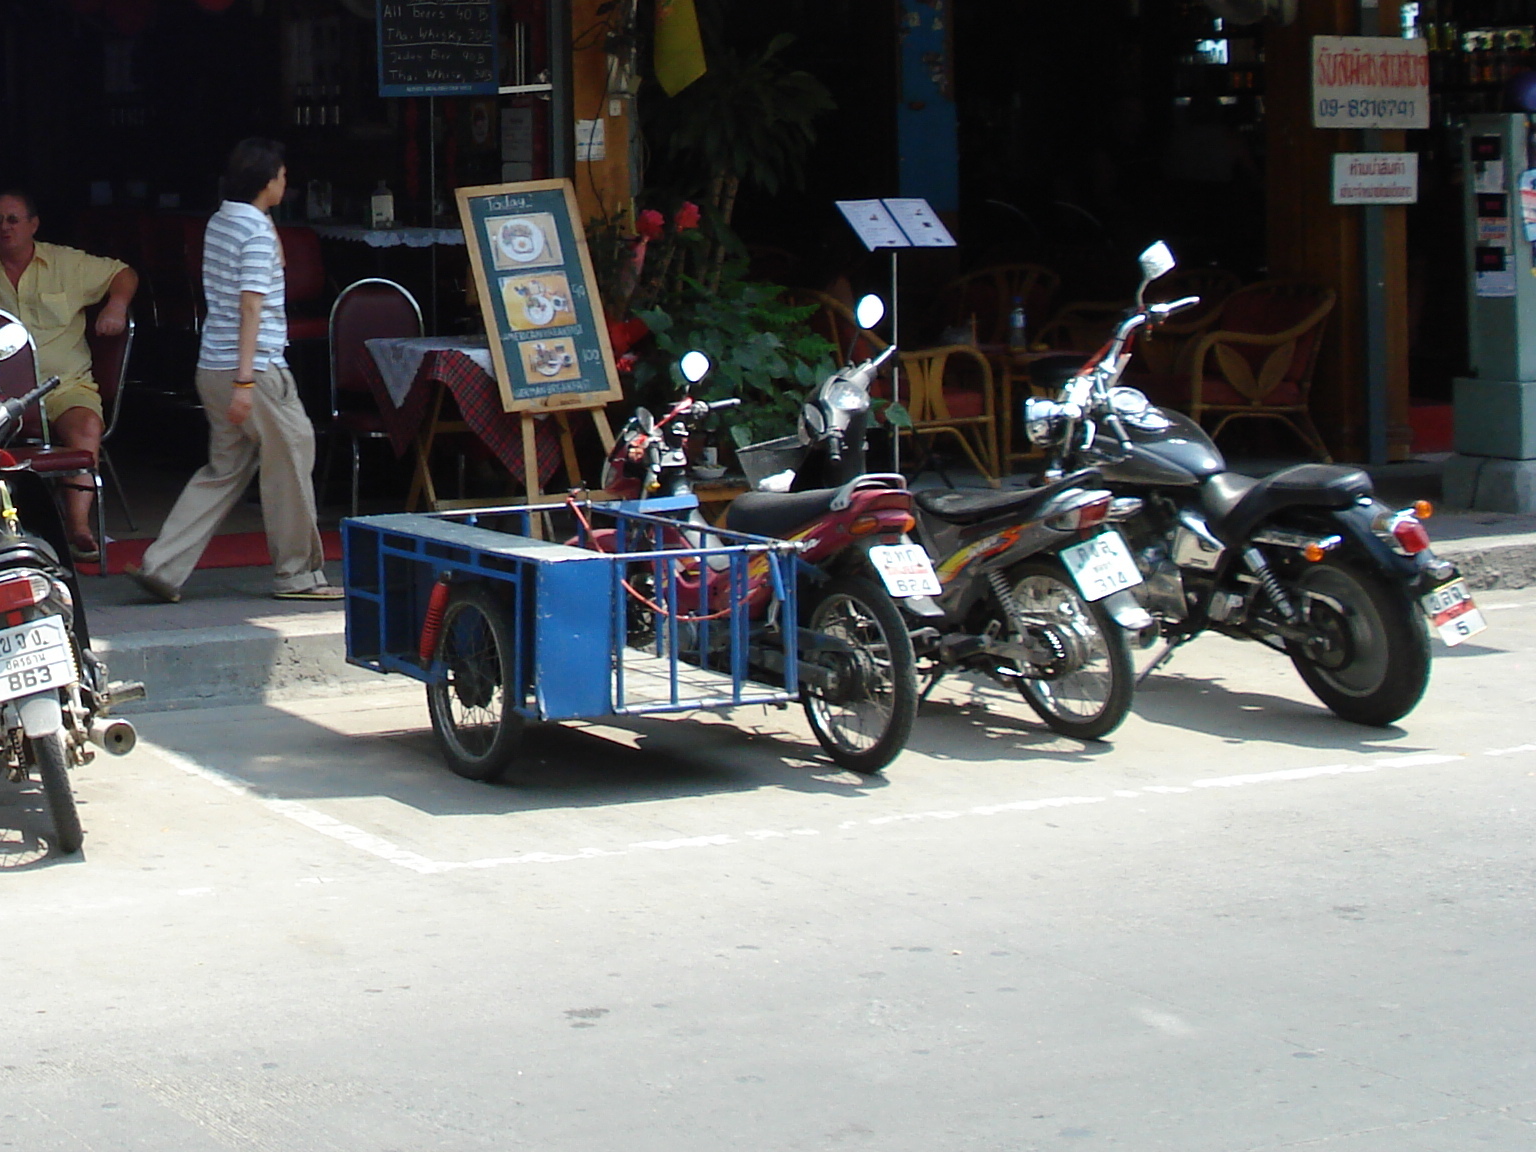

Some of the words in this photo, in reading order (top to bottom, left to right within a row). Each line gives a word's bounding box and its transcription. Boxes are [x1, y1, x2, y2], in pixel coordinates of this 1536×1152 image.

[896, 579, 931, 591] 624
[1094, 571, 1127, 592] 314
[1456, 621, 1470, 635] 5
[8, 666, 52, 691] 863
